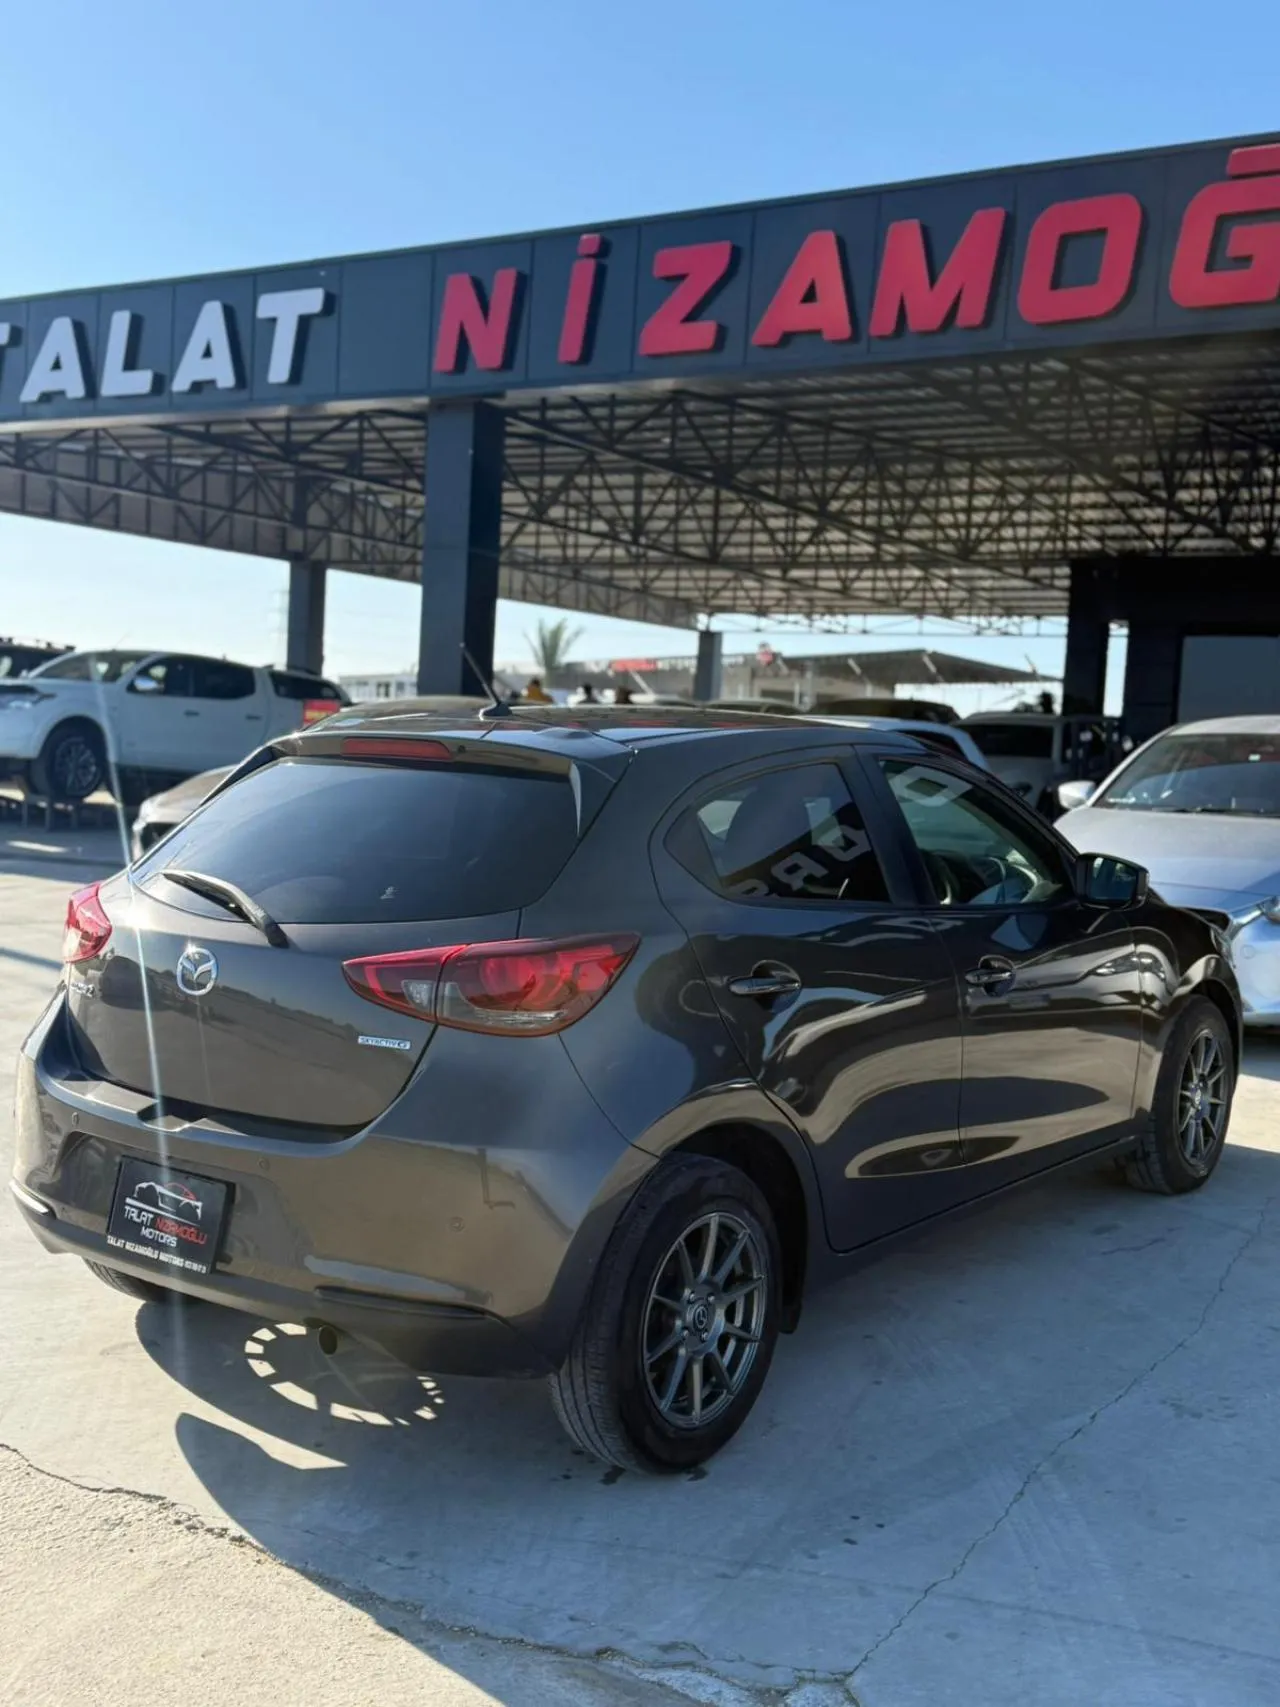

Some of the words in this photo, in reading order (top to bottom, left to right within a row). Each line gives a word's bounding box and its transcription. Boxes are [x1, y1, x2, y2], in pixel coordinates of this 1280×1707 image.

[0, 287, 326, 402] ALAT
[124, 1205, 154, 1226] TALAT
[141, 1226, 178, 1248] MOTORS
